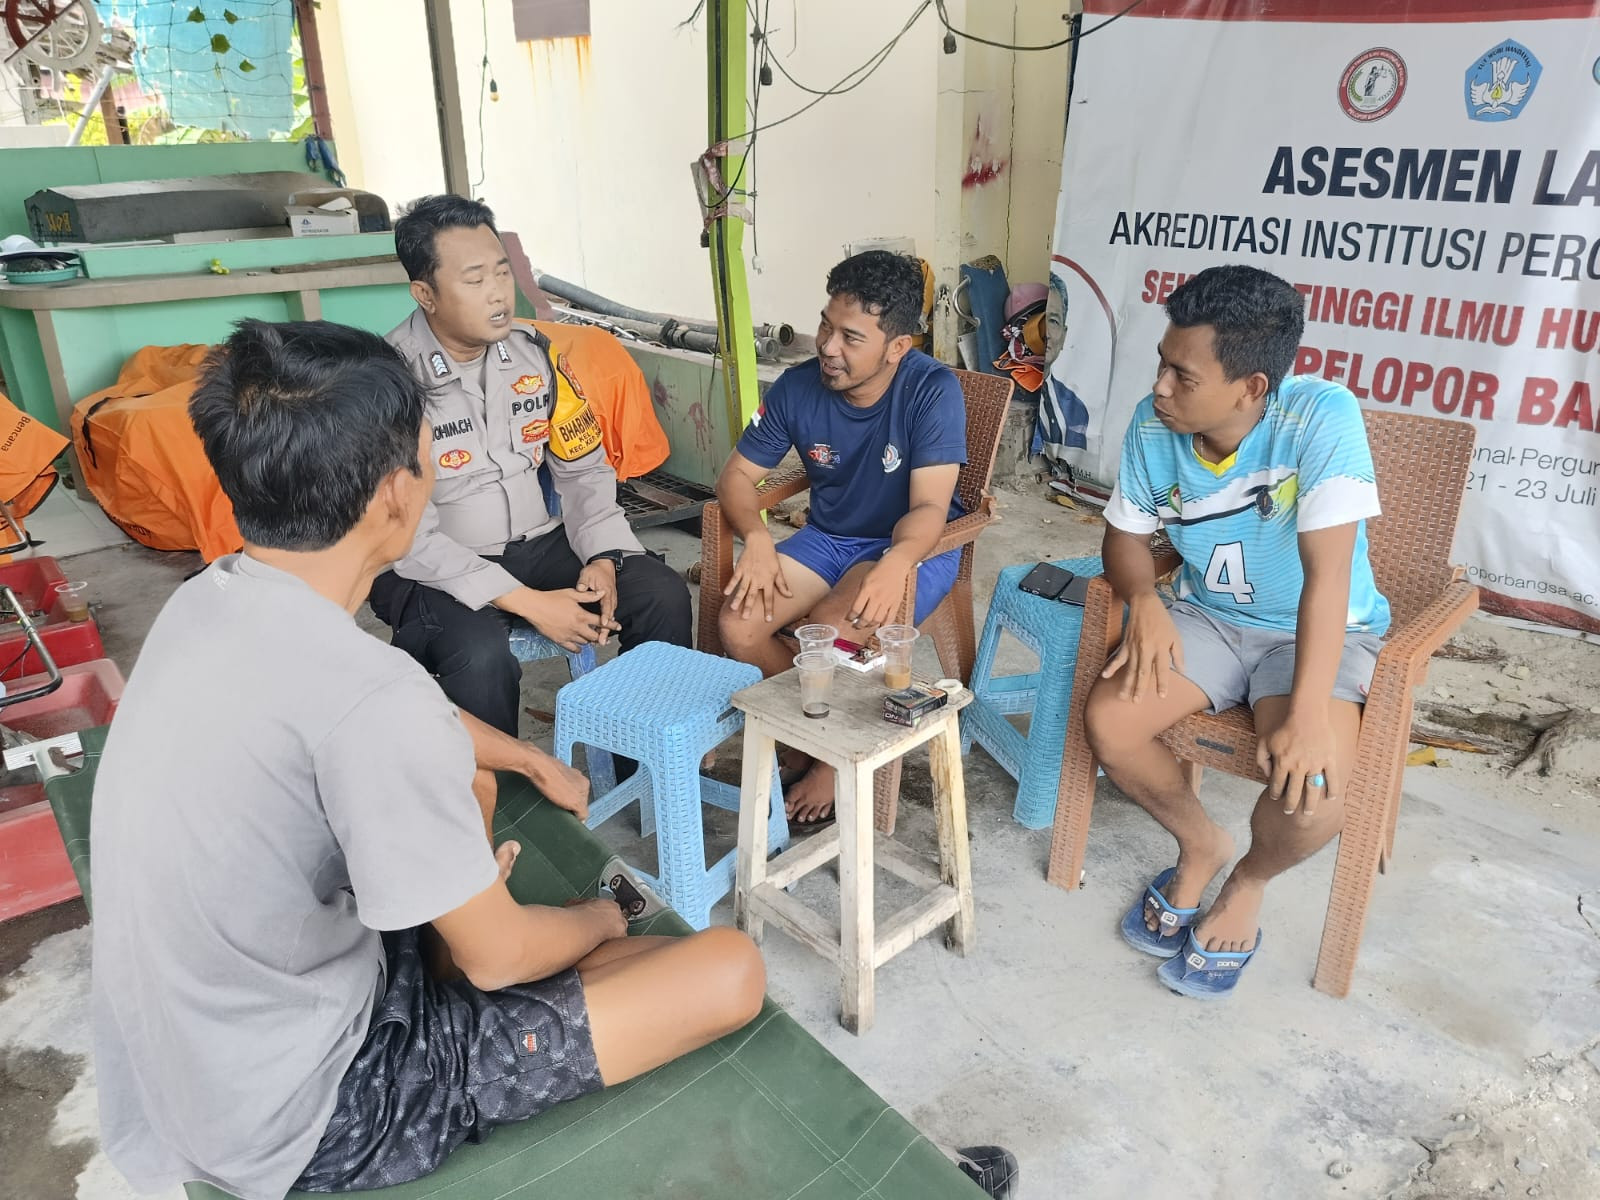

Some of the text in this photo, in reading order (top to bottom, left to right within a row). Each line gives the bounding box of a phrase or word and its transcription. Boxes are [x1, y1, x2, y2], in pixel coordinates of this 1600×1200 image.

[1262, 146, 1600, 207] ASESMEN LA
[1109, 211, 1291, 255] AKREDITASI
[1301, 219, 1487, 272] INSTITUSI
[1420, 297, 1524, 347] ILMU
[1536, 307, 1600, 353] HU
[1293, 346, 1600, 434] PELOPOR BA
[1, 416, 31, 452] Bencana
[1514, 478, 1547, 499] 23
[1555, 484, 1597, 506] Juli
[1204, 540, 1255, 604] 4
